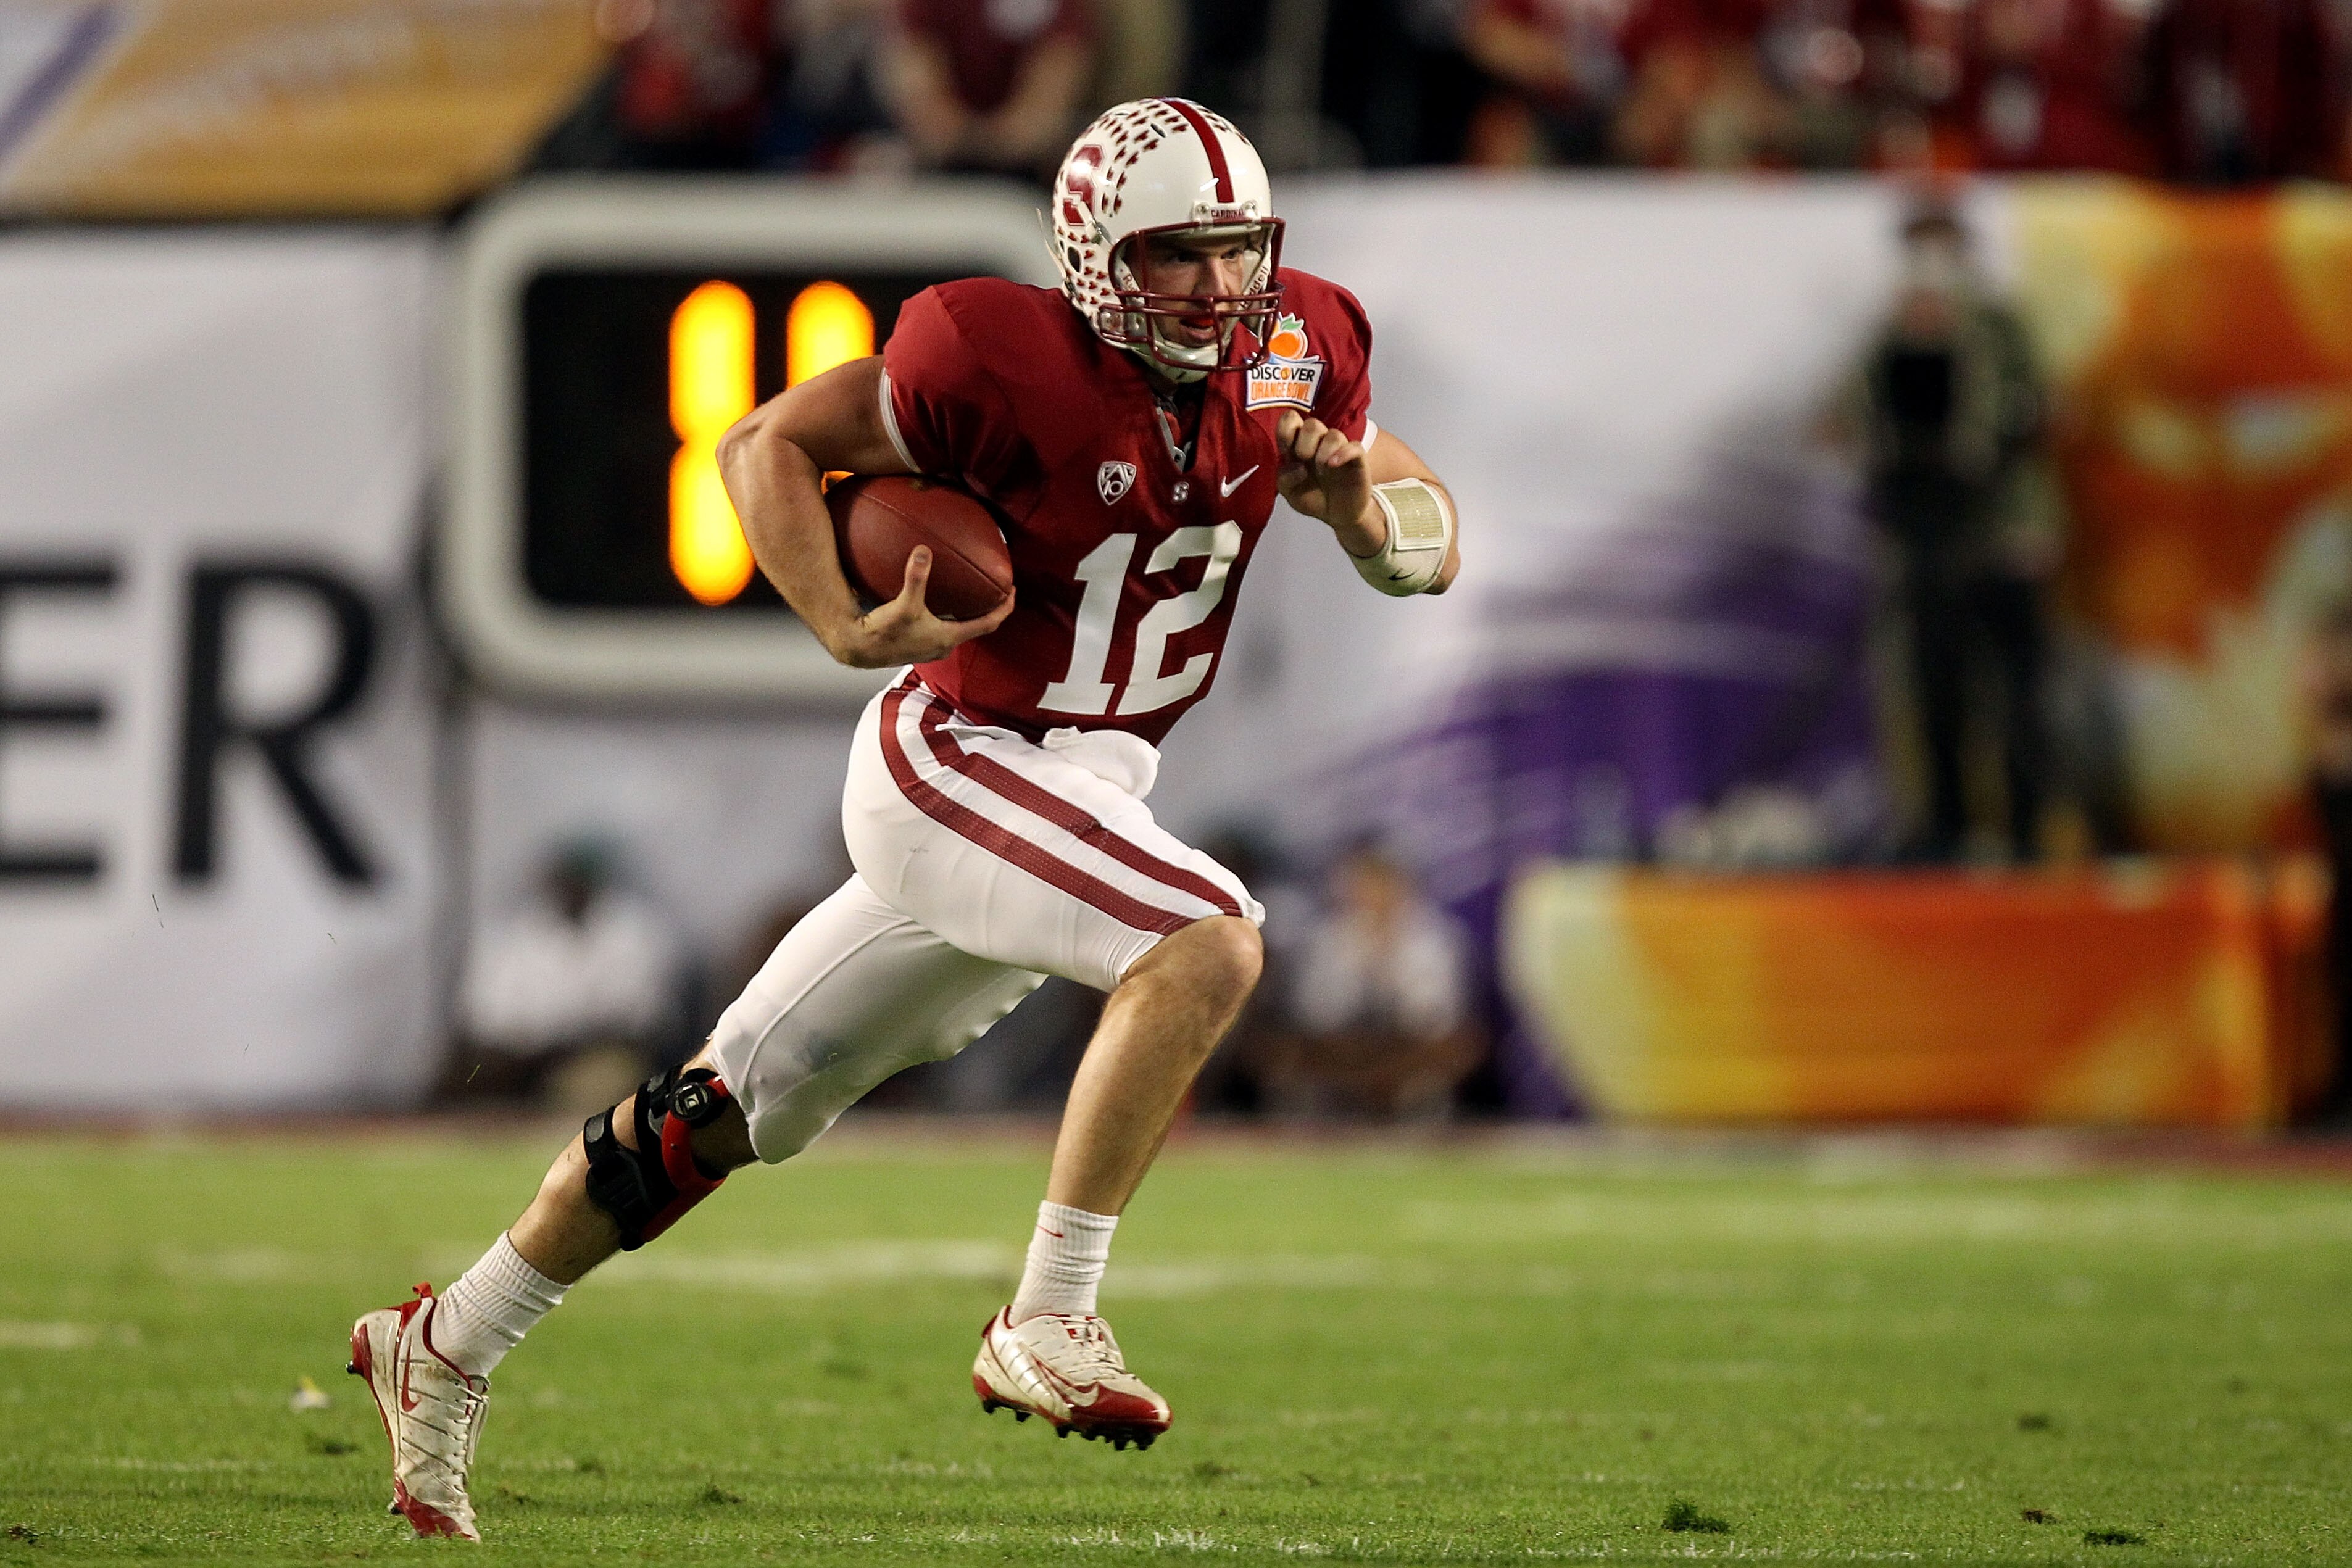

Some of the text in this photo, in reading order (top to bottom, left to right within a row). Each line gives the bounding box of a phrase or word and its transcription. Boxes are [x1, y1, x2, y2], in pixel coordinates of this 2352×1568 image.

[1252, 366, 1315, 382] DISCOVER
[1251, 381, 1311, 401] ORANGE BOWL
[1104, 480, 1124, 496] 10
[1037, 520, 1242, 716] 12
[0, 555, 381, 882] ER
